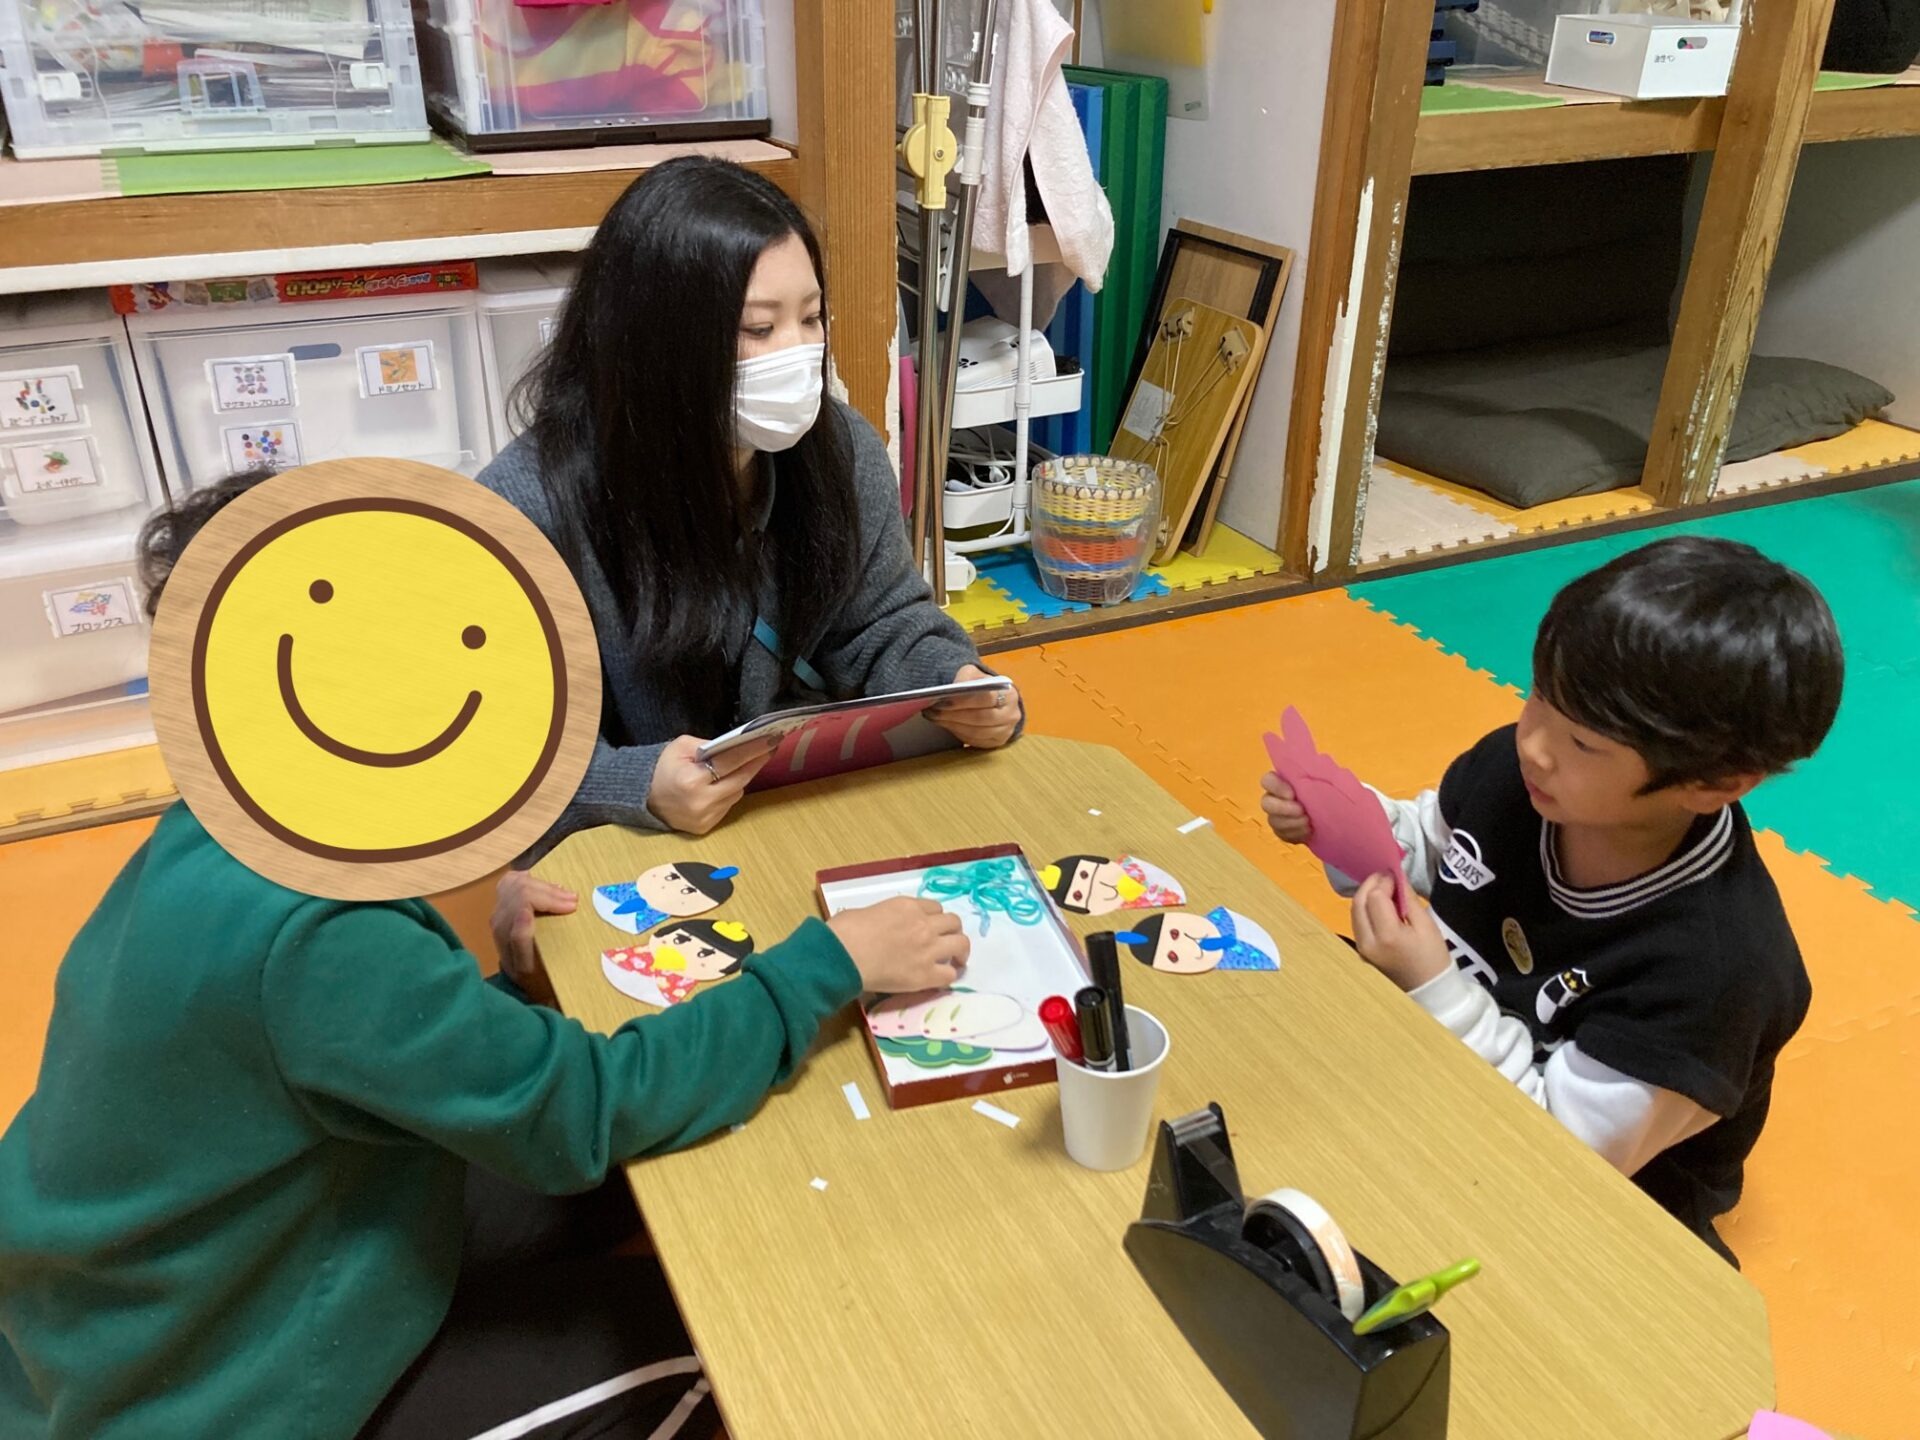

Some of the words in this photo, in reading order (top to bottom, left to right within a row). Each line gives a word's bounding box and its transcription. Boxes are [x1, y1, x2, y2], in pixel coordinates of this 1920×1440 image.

[378, 382, 425, 394] ドミノセット
[223, 399, 287, 410] マグネットブロック
[71, 618, 123, 633] ブロックス
[1453, 854, 1485, 886] DAYS
